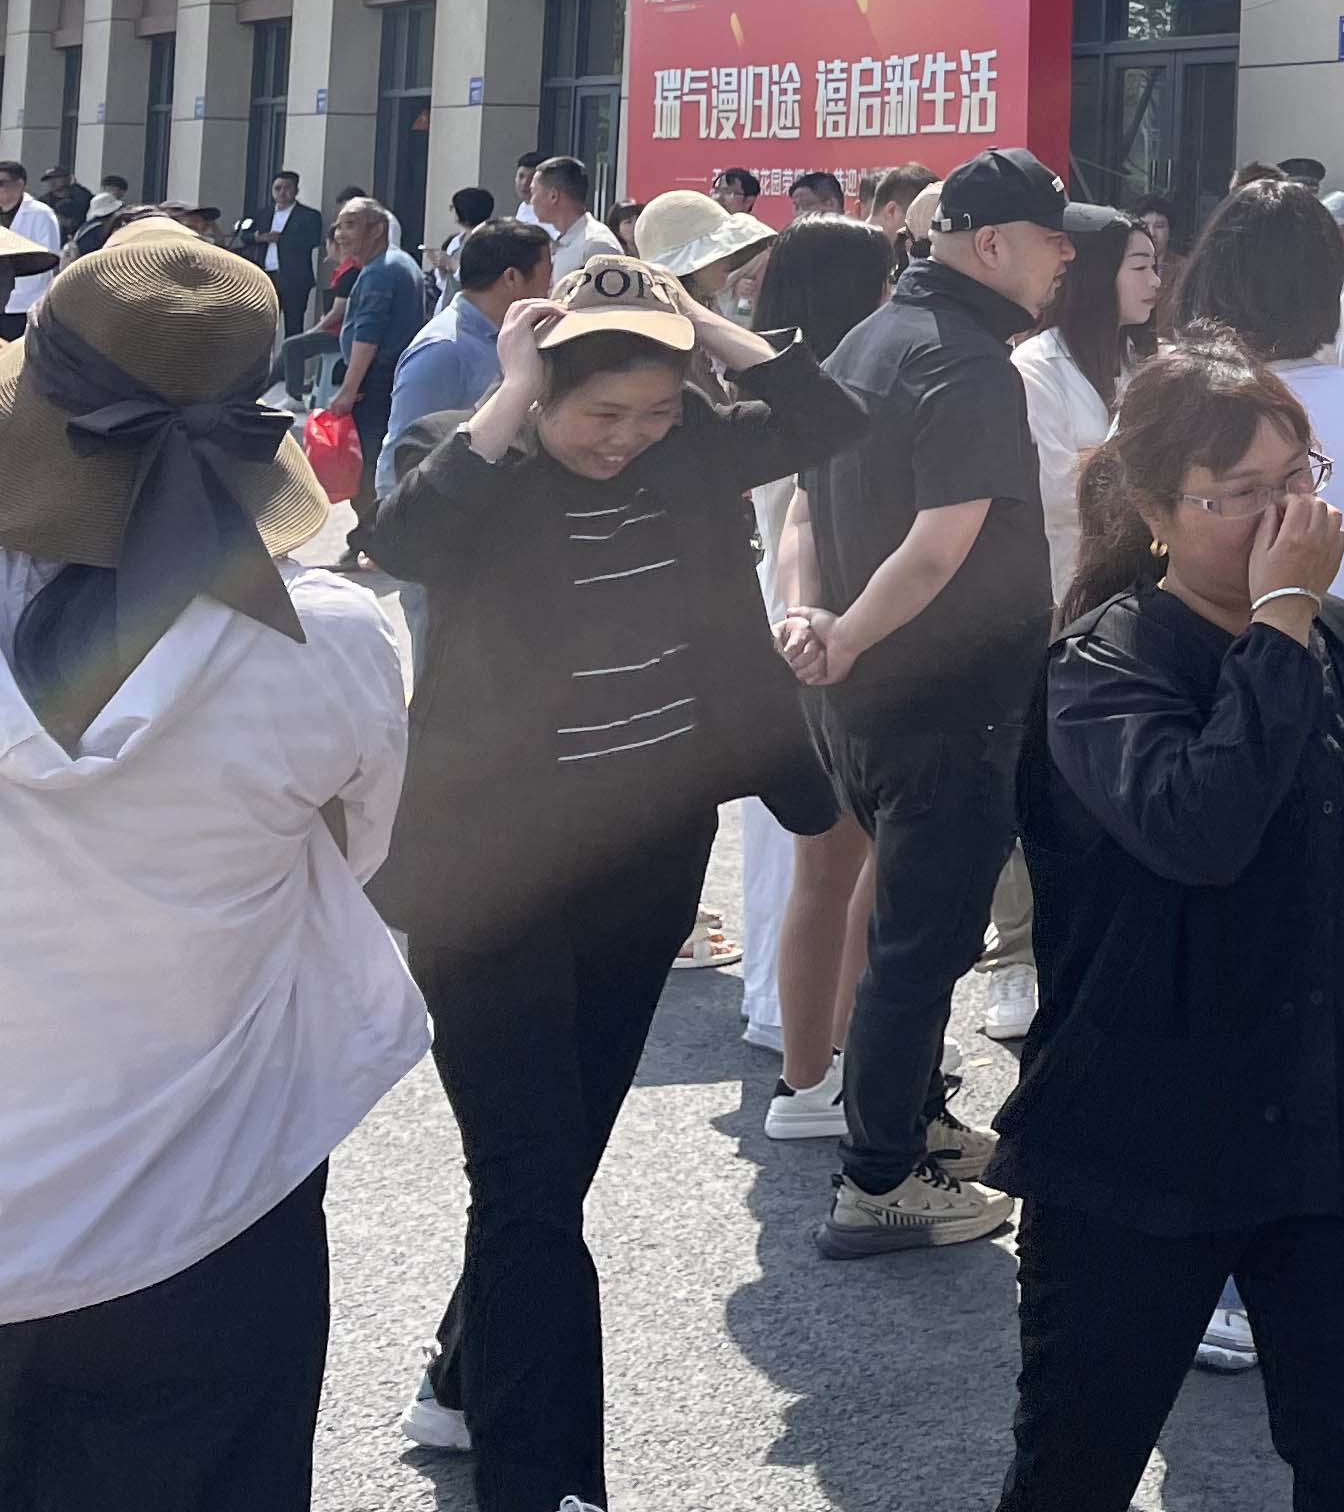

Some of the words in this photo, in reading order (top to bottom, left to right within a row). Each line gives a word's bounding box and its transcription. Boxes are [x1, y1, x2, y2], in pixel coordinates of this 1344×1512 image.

[652, 62, 801, 140] 瑞气漫归途
[815, 48, 998, 139] 禧启新生活
